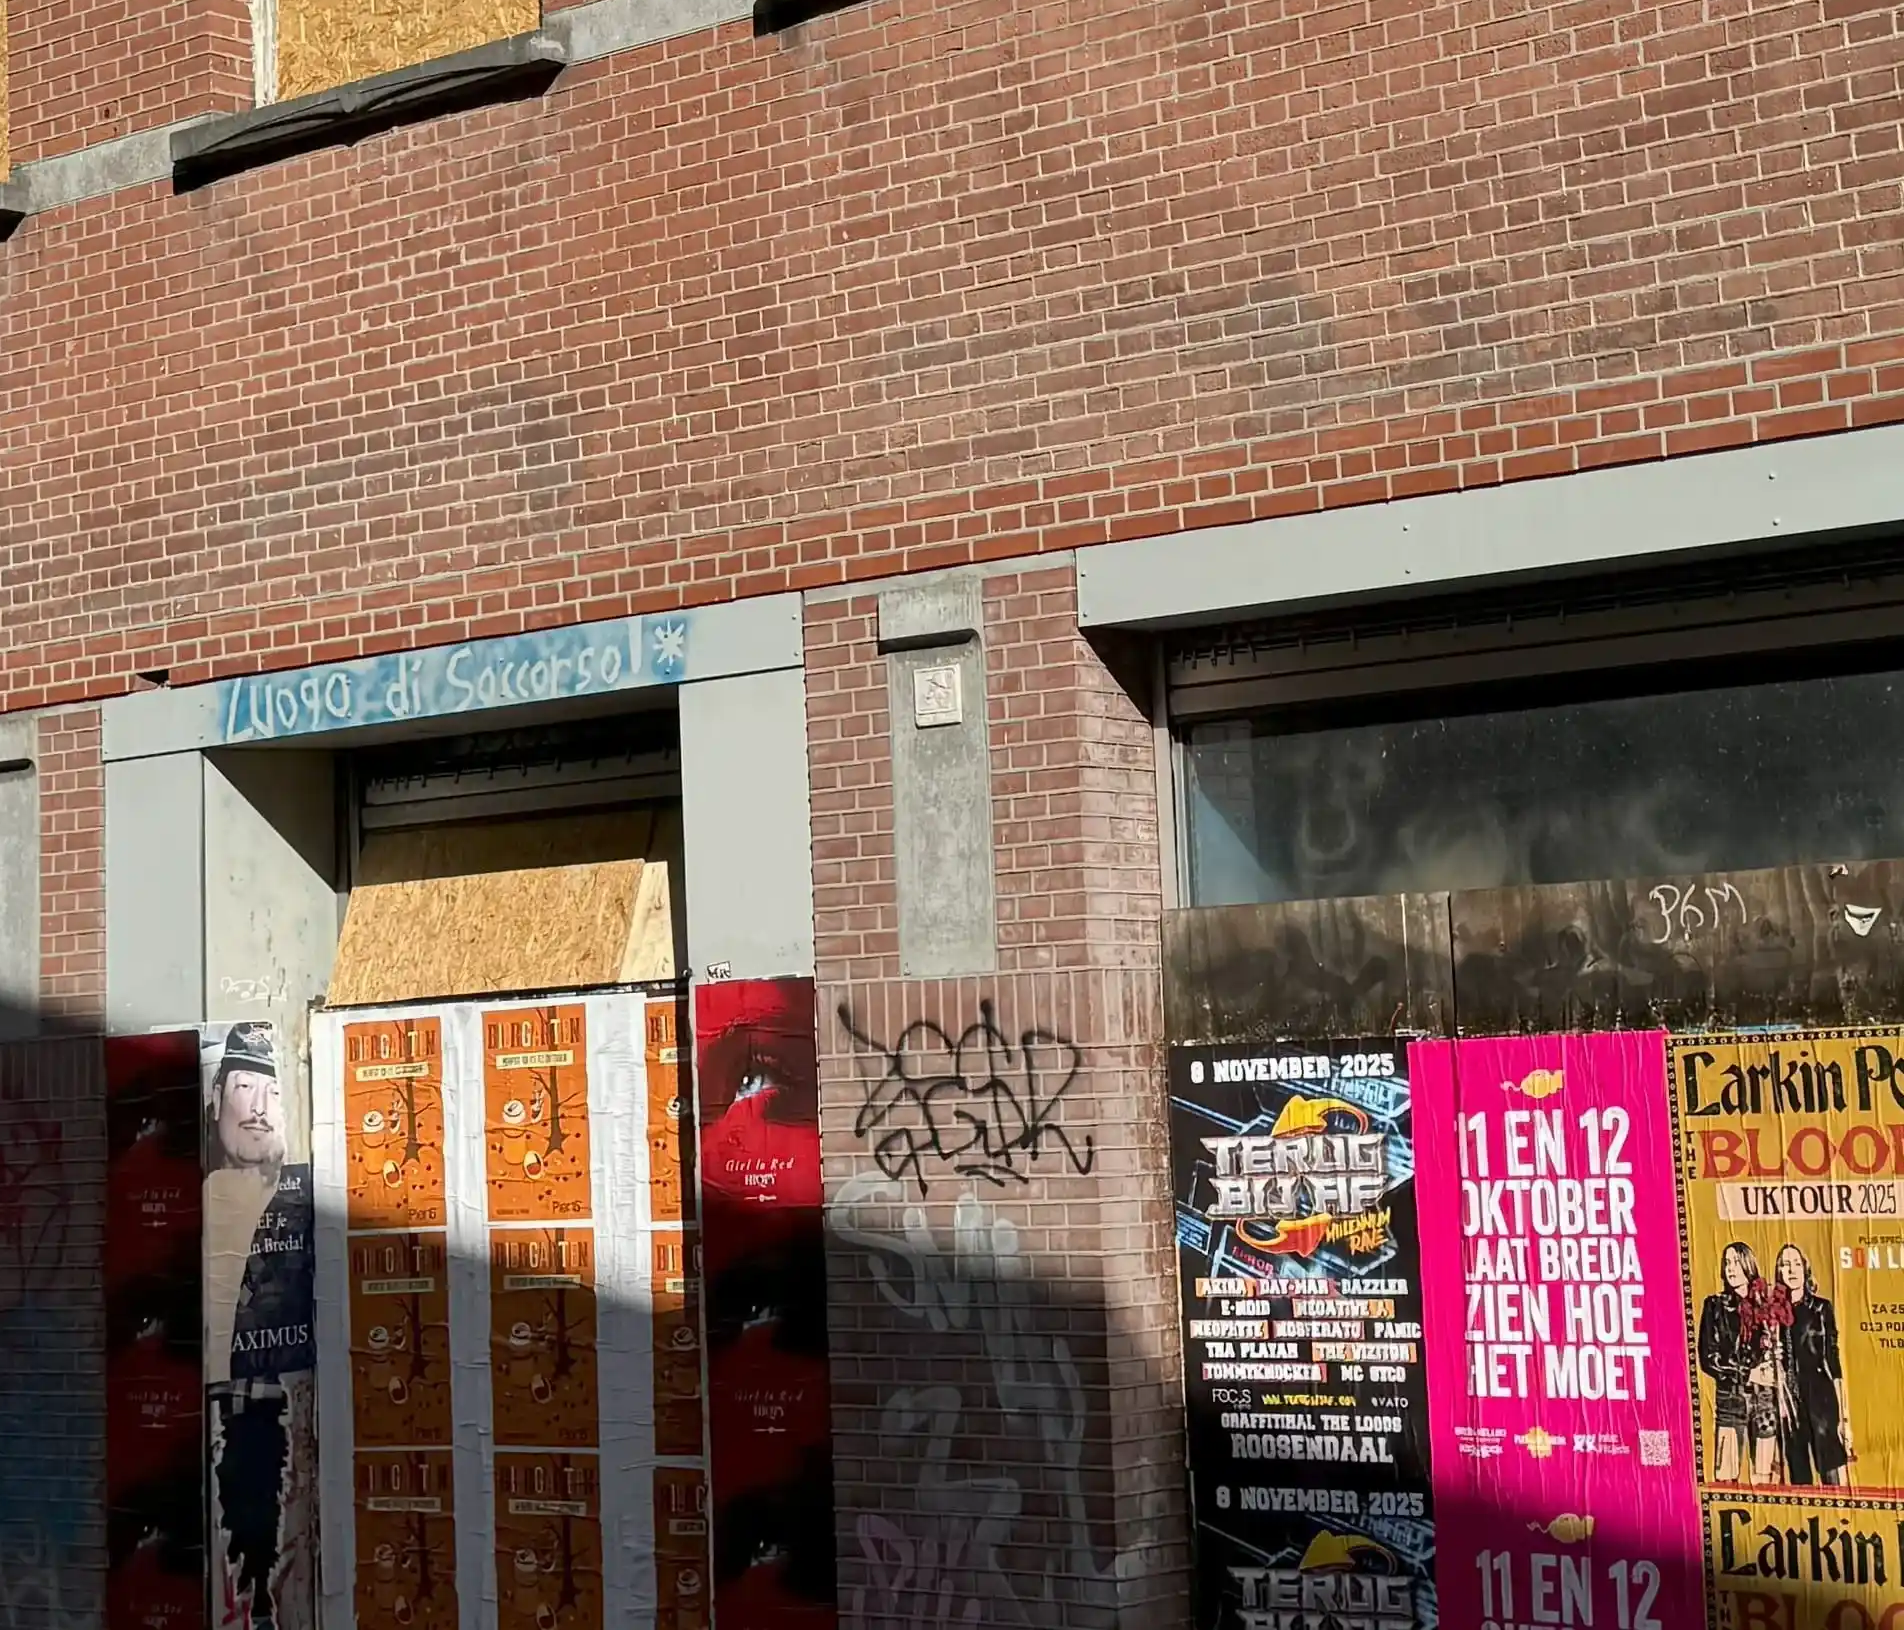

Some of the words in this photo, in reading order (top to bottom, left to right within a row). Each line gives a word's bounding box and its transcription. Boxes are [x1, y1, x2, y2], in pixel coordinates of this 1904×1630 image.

[226, 672, 352, 742] Luogo
[385, 660, 422, 716] di
[1213, 1055, 1331, 1083] NOVEMBER
[1341, 1053, 1396, 1077] 2025
[1682, 1051, 1847, 1116] Larkin
[1200, 1134, 1384, 1177] TERUG
[1504, 1109, 1568, 1178] EN
[1579, 1106, 1633, 1176] 12
[1859, 1182, 1897, 1214] 2025
[264, 1233, 304, 1254] Breda!
[1840, 1247, 1880, 1269] SON
[1539, 1238, 1644, 1282] BREDA
[1341, 1279, 1409, 1295] DAZZLER
[1464, 1284, 1551, 1344] ZIEN
[1564, 1284, 1649, 1344] HOE
[1872, 1304, 1888, 1314] ZA
[232, 1323, 309, 1352] AXIMUS
[1373, 1322, 1423, 1339] PANIC
[1205, 1342, 1236, 1358] THA
[1315, 1343, 1345, 1360] THE
[1341, 1365, 1364, 1382] MC
[1544, 1345, 1651, 1401] MOET
[1320, 1414, 1350, 1431] THE
[1355, 1416, 1403, 1433] LOODS
[1230, 1433, 1394, 1464] ROOSENDAAL
[1240, 1486, 1360, 1515] NOVEMBER
[1368, 1492, 1425, 1518] 2025
[1718, 1508, 1887, 1587] Larkin
[1476, 1549, 1514, 1620] 11
[1530, 1553, 1594, 1627] EN
[1608, 1559, 1663, 1630] 12
